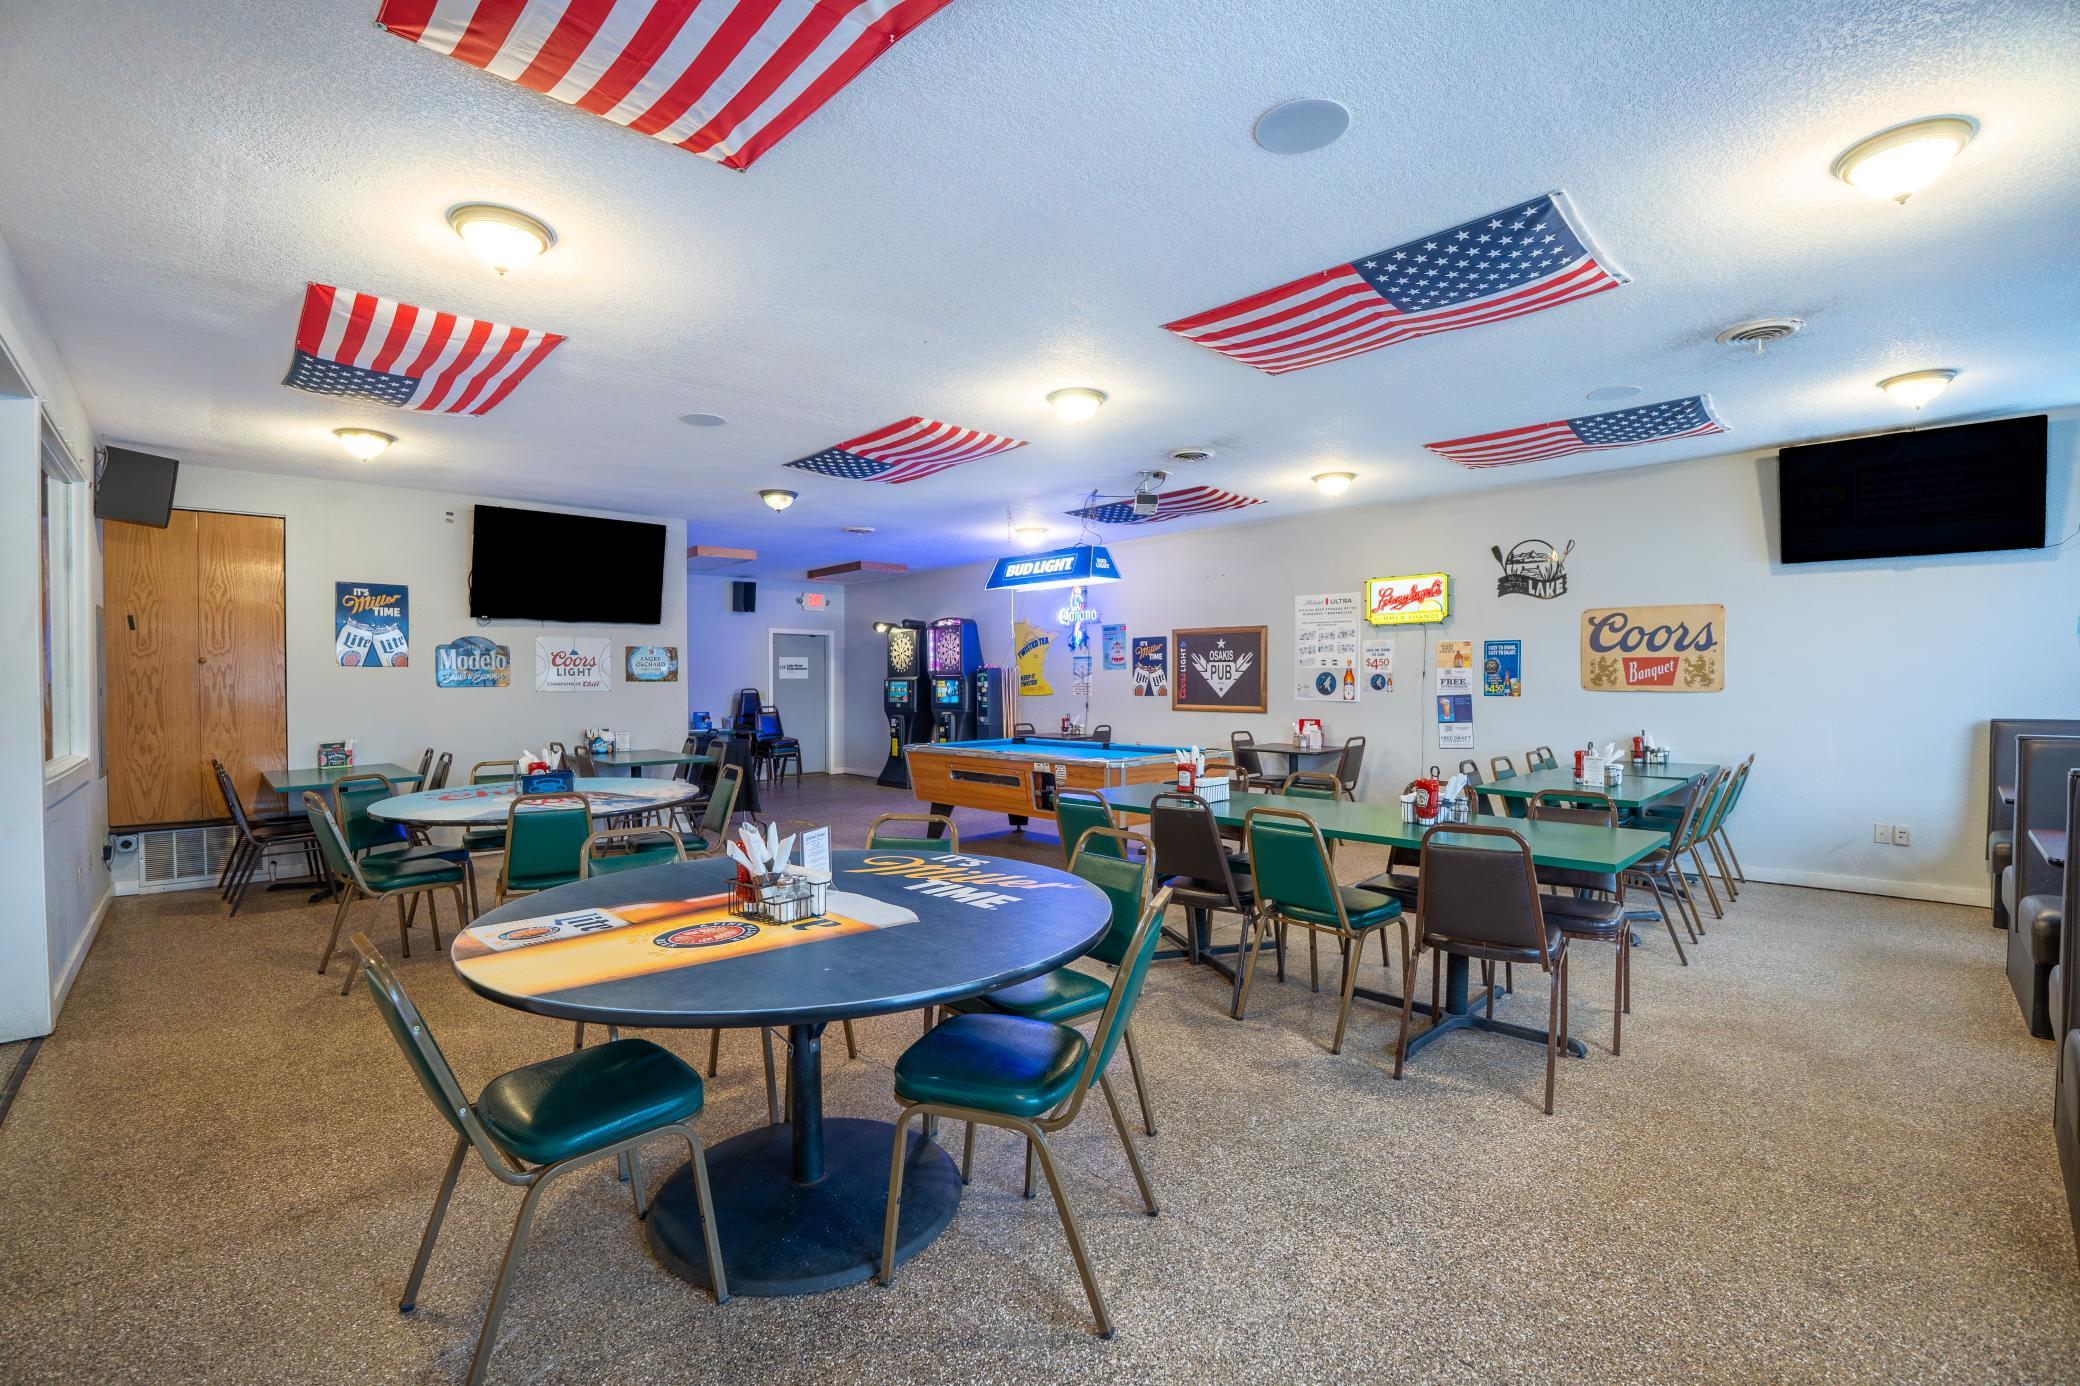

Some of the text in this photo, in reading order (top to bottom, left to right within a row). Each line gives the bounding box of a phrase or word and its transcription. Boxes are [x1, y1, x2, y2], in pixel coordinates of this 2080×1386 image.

[1005, 557, 1074, 578] BUD LIGHT
[354, 588, 370, 596] IT'S
[1528, 578, 1564, 597] LAKE
[342, 594, 401, 614] Miller
[372, 607, 400, 617] TIME
[1588, 612, 1718, 653] Coors
[1018, 636, 1050, 660] TWISTED TEA
[1135, 642, 1164, 660] Miller
[1209, 650, 1234, 661] OSAKIS
[440, 648, 507, 671] Modelo
[550, 651, 597, 668] Coors
[556, 668, 593, 677] LIGHT
[1210, 664, 1232, 680] PUB
[1629, 660, 1675, 683] Banquet
[930, 854, 990, 867] IT'S
[843, 856, 1082, 889] Miller
[554, 912, 614, 932] Lite
